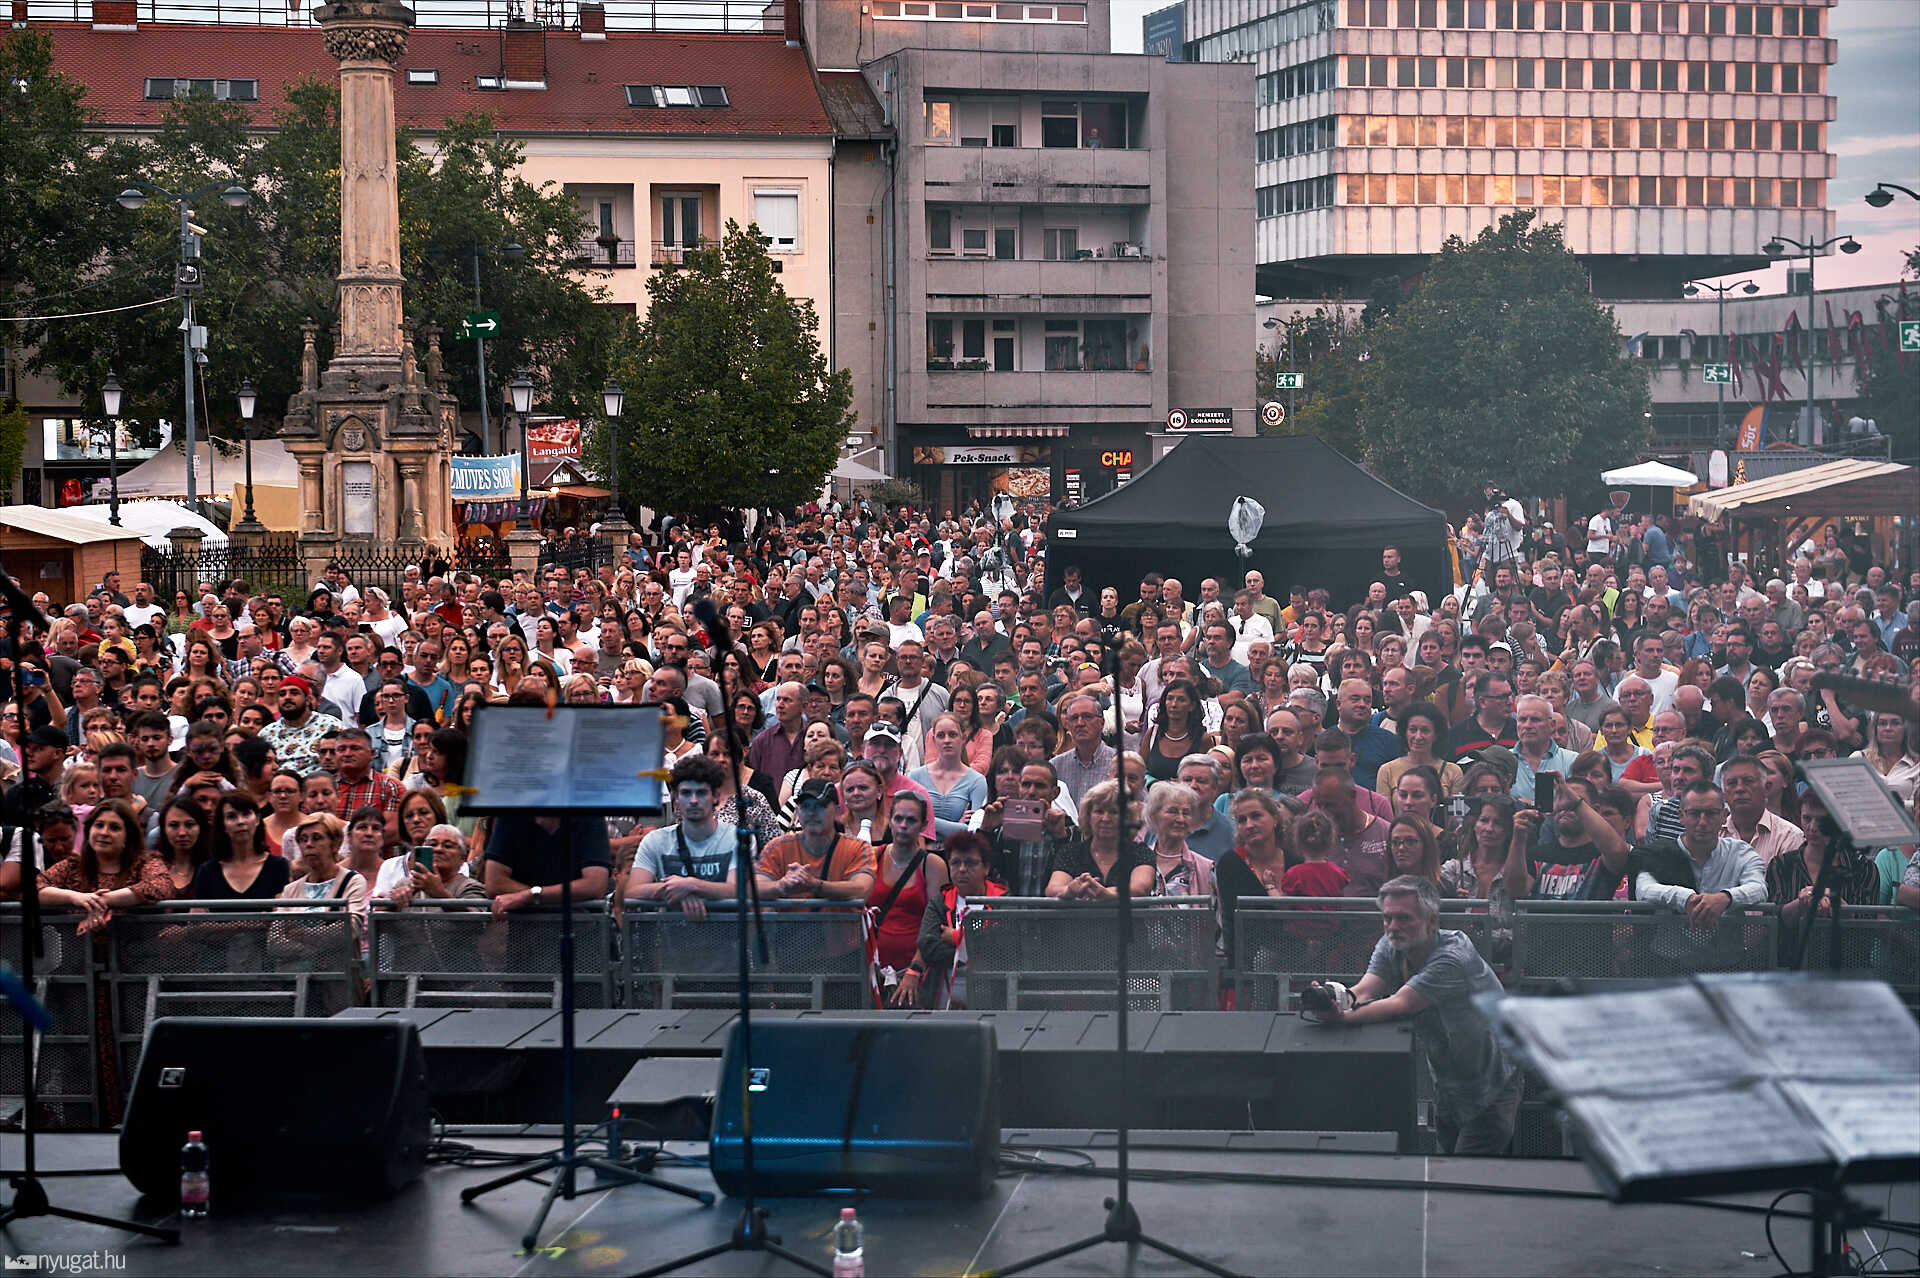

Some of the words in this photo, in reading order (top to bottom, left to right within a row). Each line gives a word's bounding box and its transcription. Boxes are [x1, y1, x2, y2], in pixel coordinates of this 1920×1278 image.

[532, 445, 578, 457] Langalló
[952, 453, 1012, 463] Pek-Snack
[492, 463, 513, 489] SÖR
[700, 862, 720, 876] OUT
